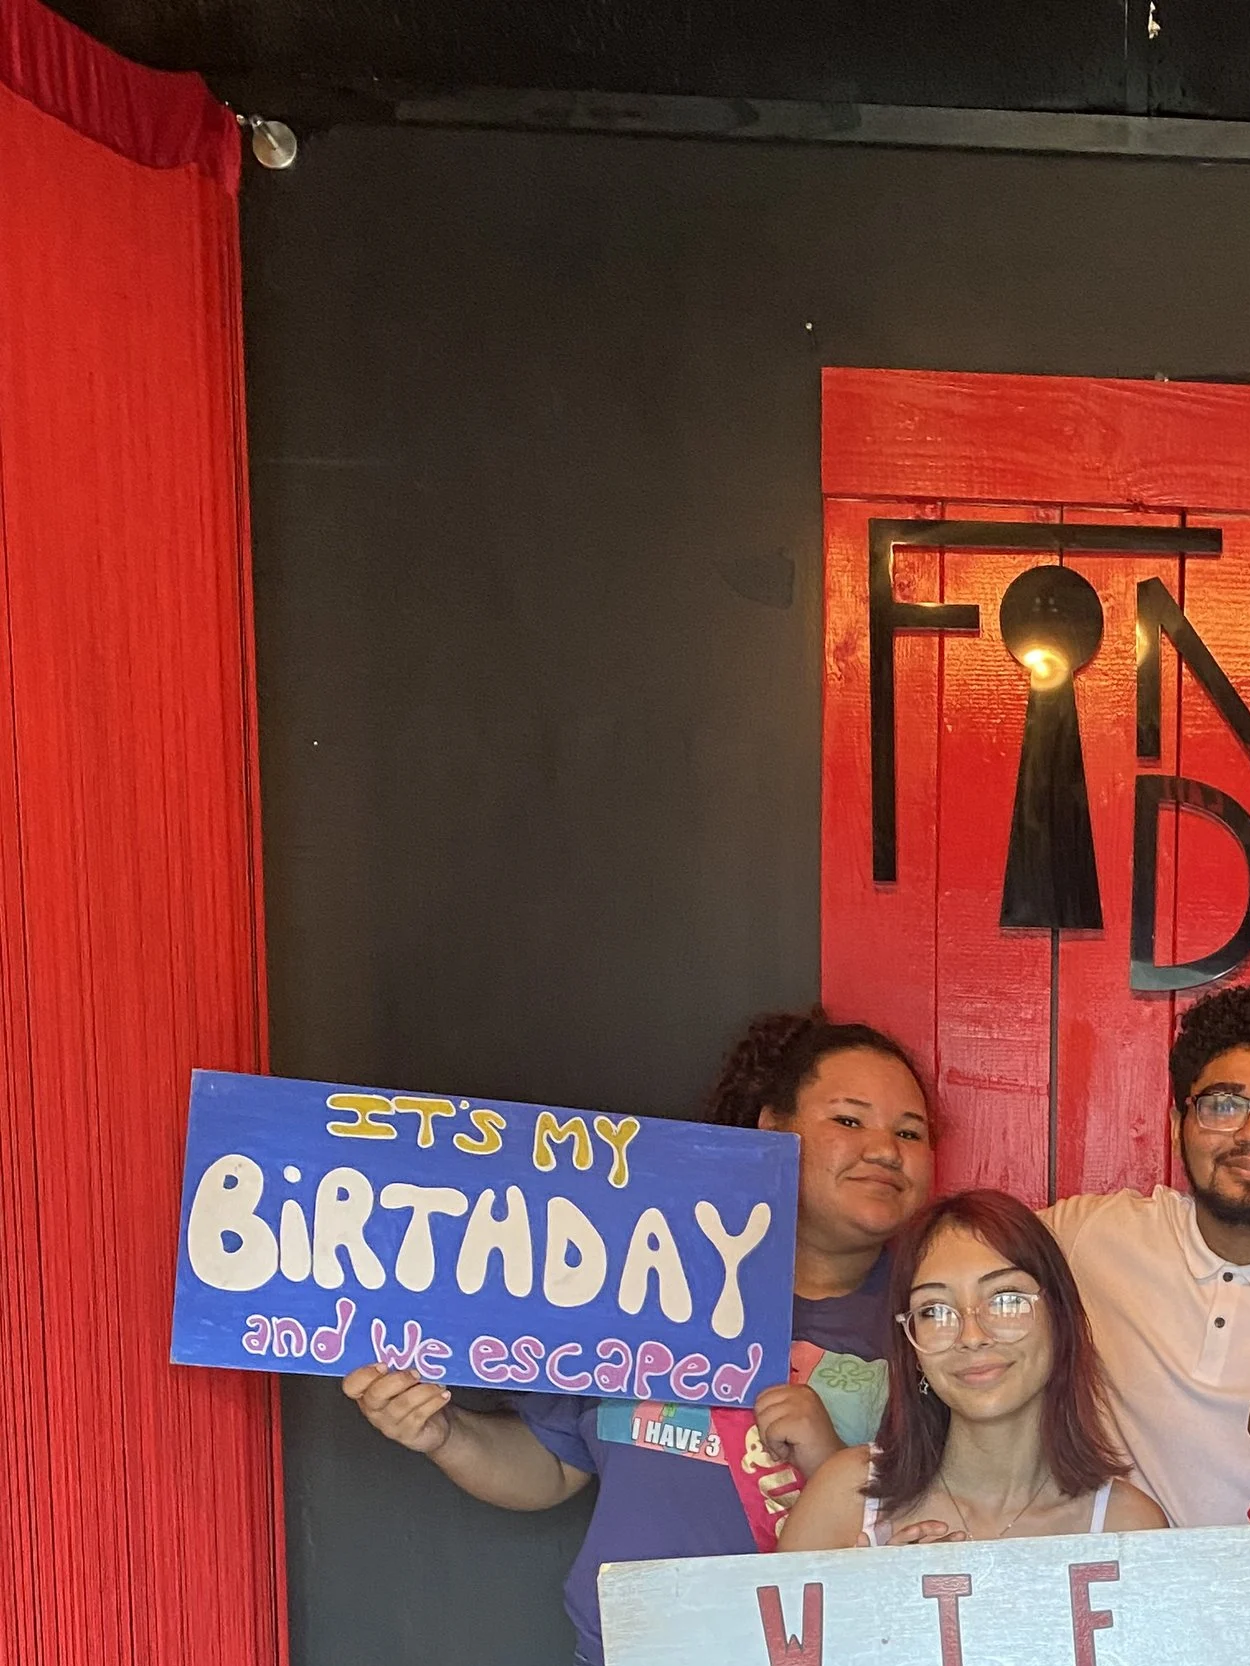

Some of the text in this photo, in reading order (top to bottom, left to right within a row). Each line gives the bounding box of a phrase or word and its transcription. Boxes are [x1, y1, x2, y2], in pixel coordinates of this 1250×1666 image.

[327, 1093, 641, 1189] IT'S MY
[242, 1297, 356, 1364] and
[469, 1335, 763, 1404] escaped
[631, 1417, 641, 1440] I
[645, 1420, 703, 1453] HAVE
